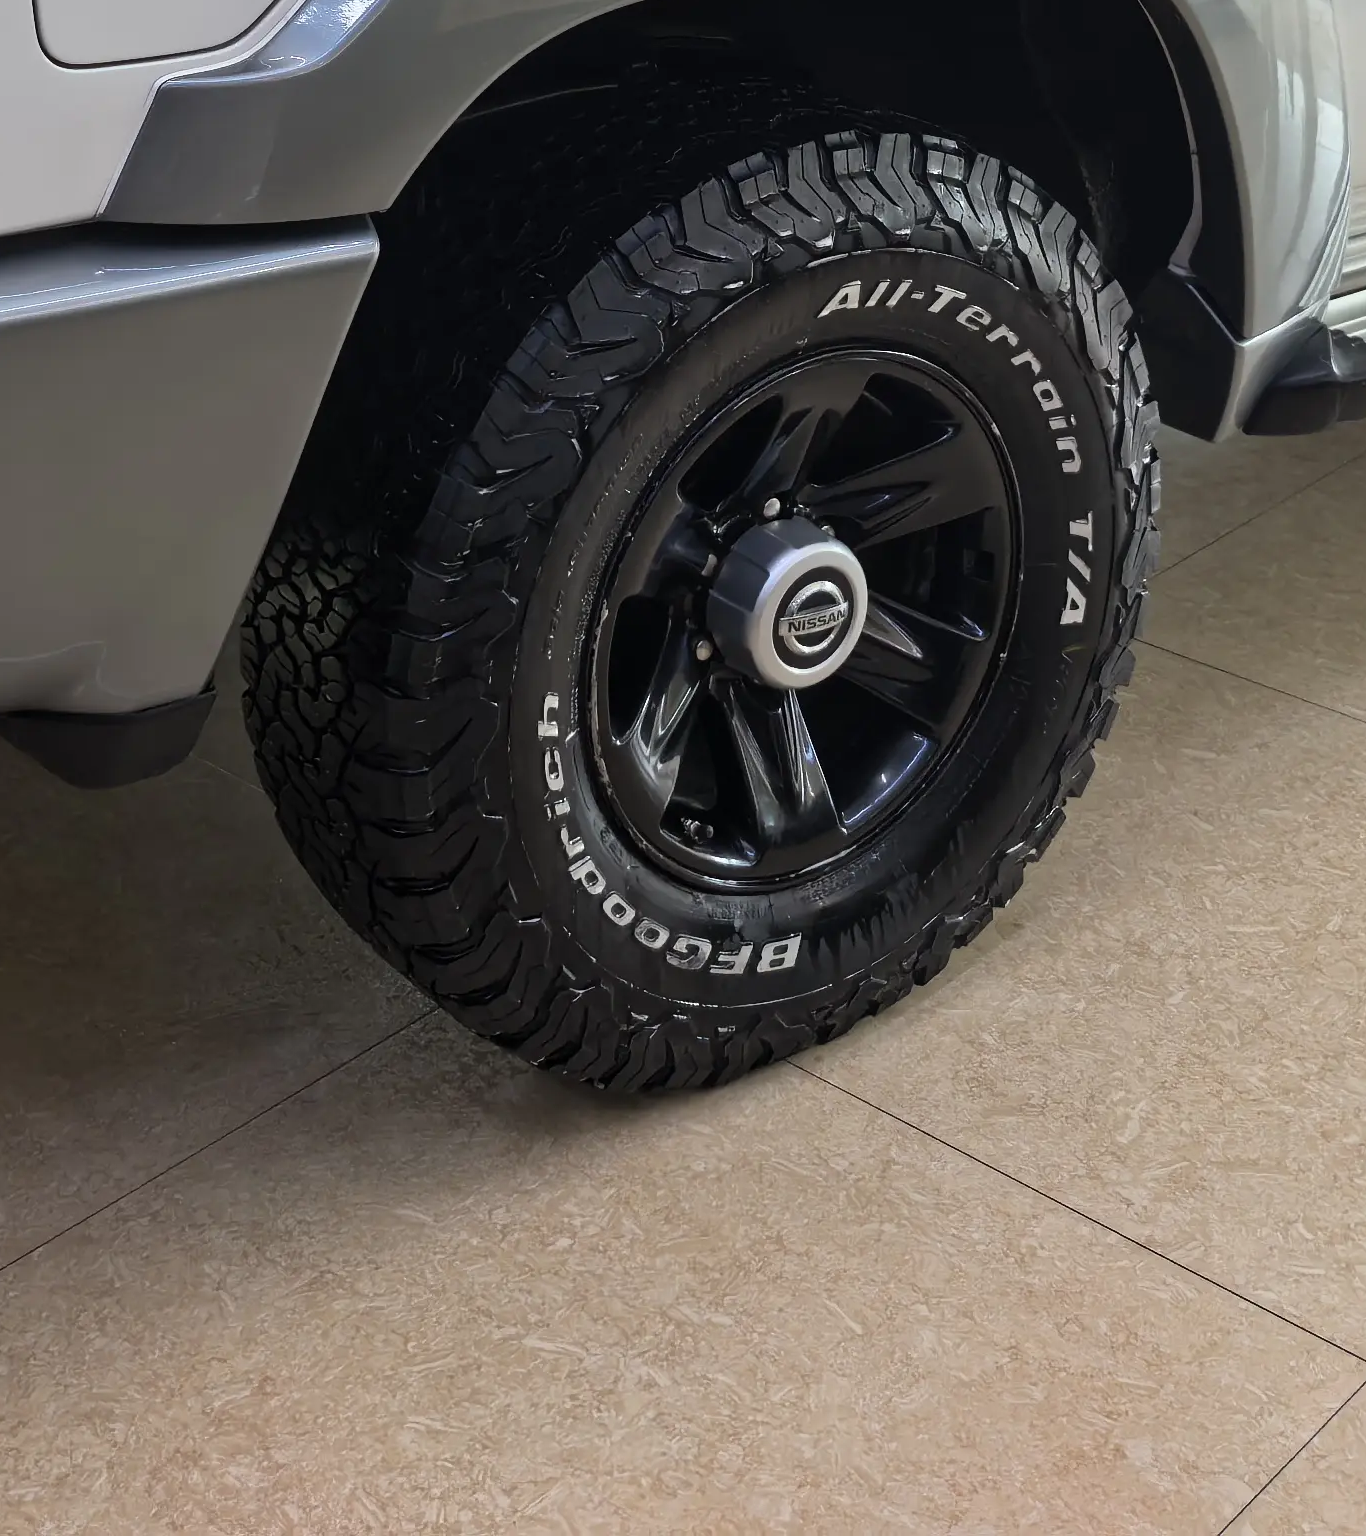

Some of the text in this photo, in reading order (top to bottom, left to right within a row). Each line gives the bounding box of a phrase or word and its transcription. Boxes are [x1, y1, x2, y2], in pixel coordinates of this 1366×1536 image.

[817, 277, 1095, 625] All-Terrain T/A
[787, 609, 847, 633] NISSAN
[537, 691, 802, 975] BFGoodrich
